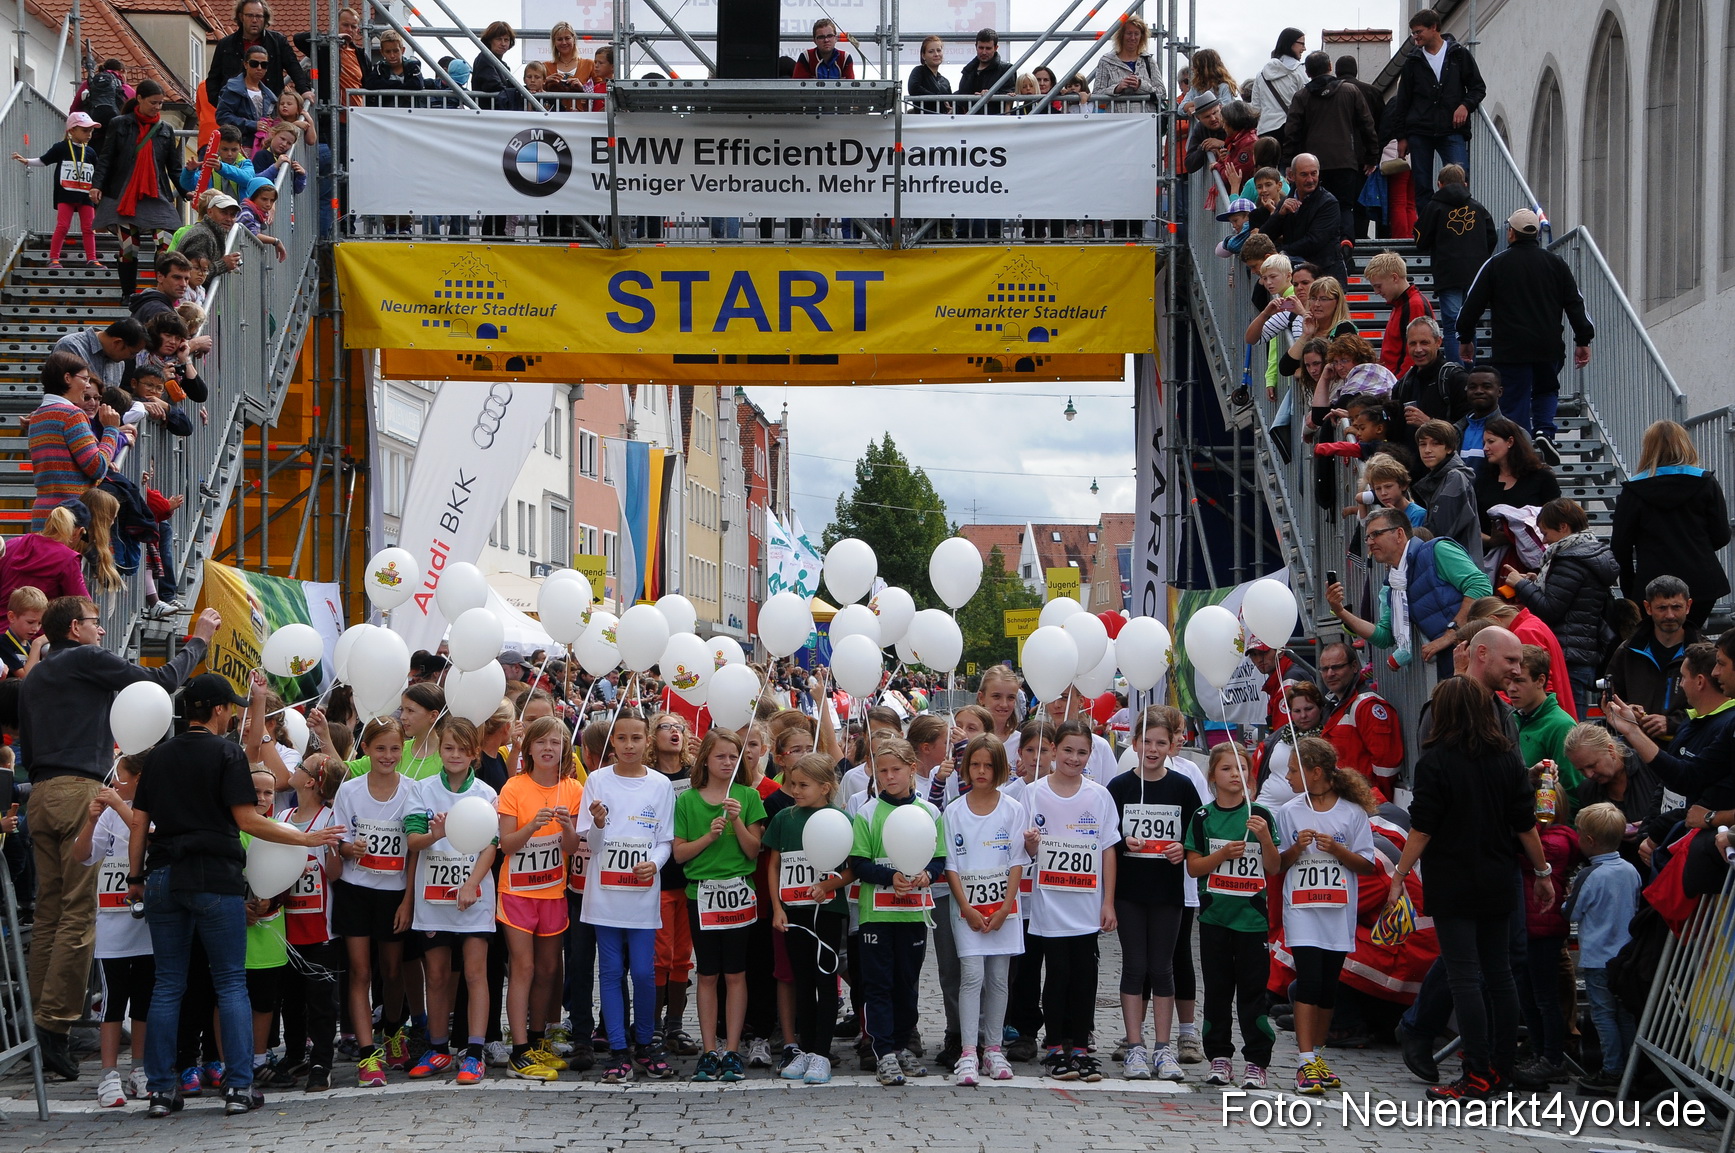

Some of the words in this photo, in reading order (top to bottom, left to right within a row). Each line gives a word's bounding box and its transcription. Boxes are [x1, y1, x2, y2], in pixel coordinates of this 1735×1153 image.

[591, 137, 684, 164] BMW
[694, 138, 1007, 173] EfficientDynamics
[65, 168, 92, 182] 7340
[591, 173, 685, 196] Weniger
[690, 174, 811, 193] Verbrauch.
[819, 176, 875, 193] Mehr
[882, 176, 1009, 194] Fahrfreude.
[380, 299, 478, 316] Neumarkter
[482, 302, 558, 318] Stadtlauf
[606, 270, 885, 334] START
[935, 305, 1029, 319] Neumarkter
[1033, 305, 1107, 320] Stadtlauf
[413, 538, 451, 616] Audi
[439, 467, 477, 534] BKK
[1048, 581, 1079, 589] Jugend-
[1056, 590, 1072, 598] lauf
[231, 629, 262, 666] Neuma
[1129, 818, 1176, 839] 7394
[529, 839, 557, 848] Neumarkt
[1041, 840, 1061, 848] PARTL
[515, 847, 560, 872] 7170
[607, 849, 648, 870] 7001
[1046, 850, 1093, 873] 7280
[104, 871, 126, 892] 72
[429, 865, 471, 885] 7285
[528, 873, 553, 884] Merle
[617, 875, 639, 884] Julia
[978, 872, 1004, 880] Neumarkt
[1044, 873, 1092, 886] Anna-Maria
[1215, 877, 1258, 890] Cassandra
[1298, 866, 1342, 887] 7012
[703, 887, 751, 910] 7002
[890, 895, 918, 905] Janika
[966, 880, 1008, 904] 7335
[1307, 891, 1332, 901] Laura
[715, 913, 746, 923] Jasmin
[863, 933, 879, 944] 112
